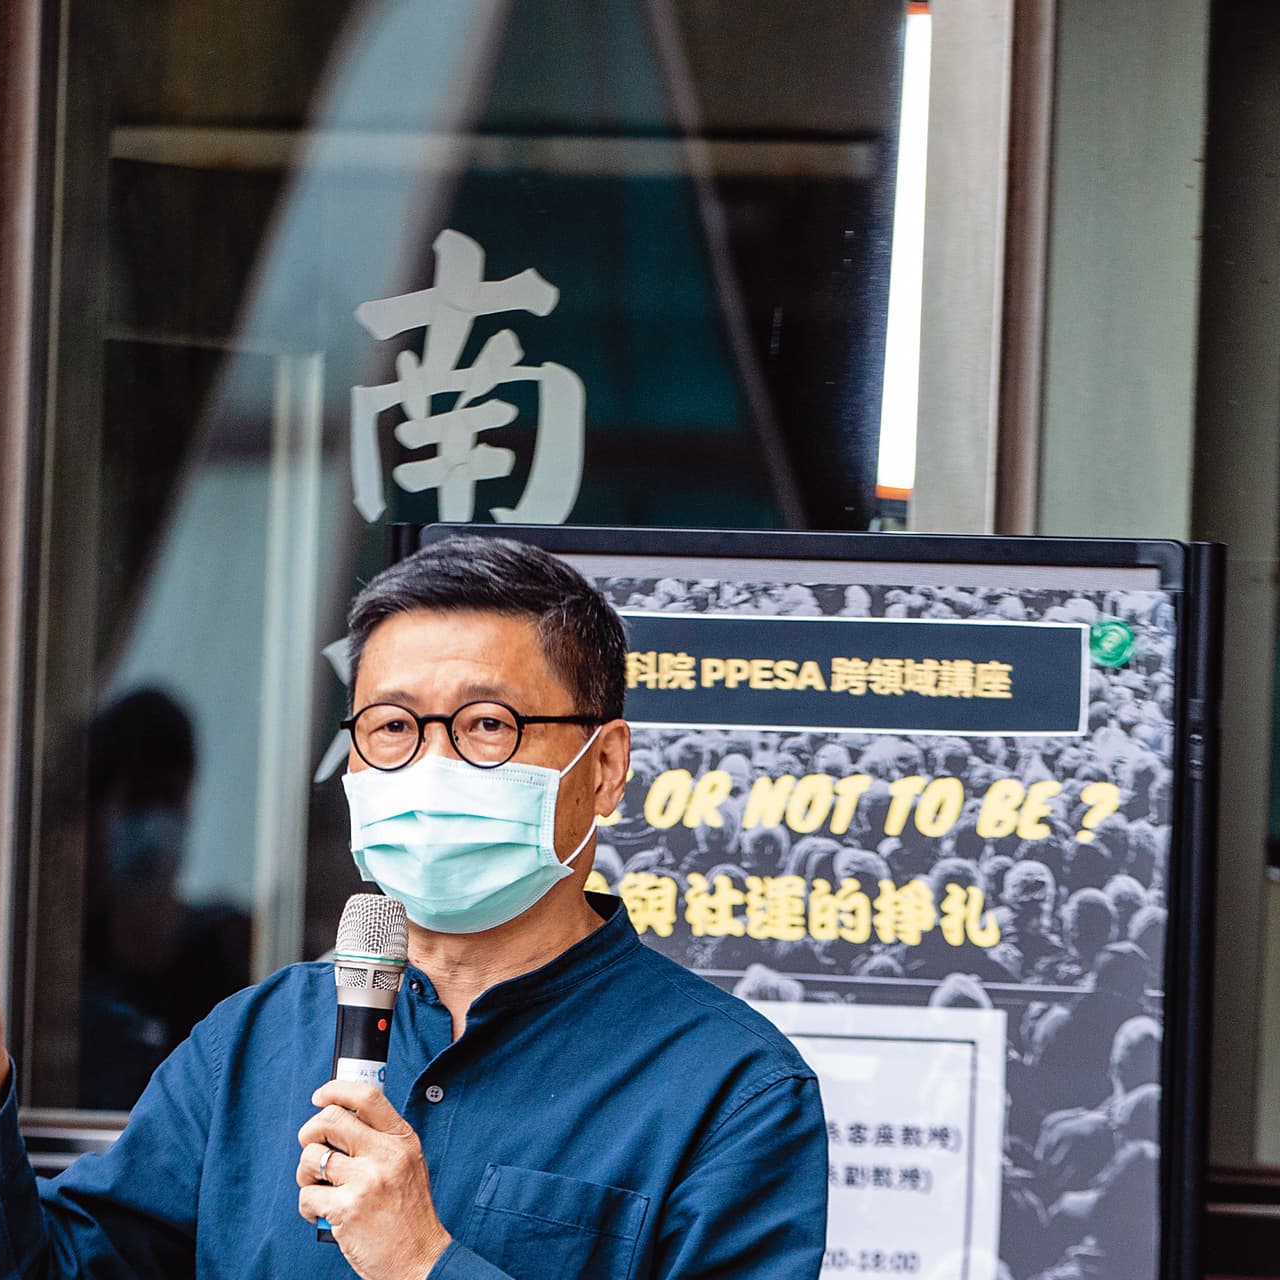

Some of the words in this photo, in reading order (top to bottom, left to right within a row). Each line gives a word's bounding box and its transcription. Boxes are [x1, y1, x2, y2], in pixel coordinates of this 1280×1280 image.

[624, 651, 697, 690] 科院
[701, 657, 827, 691] PPESA
[830, 656, 1014, 699] 跨領域講座
[644, 769, 732, 830] OR
[743, 773, 873, 836] NOT
[884, 776, 965, 839] TO
[975, 778, 1063, 842] BE
[1075, 781, 1123, 844] ?
[584, 870, 1002, 948] 與社運的掙扎
